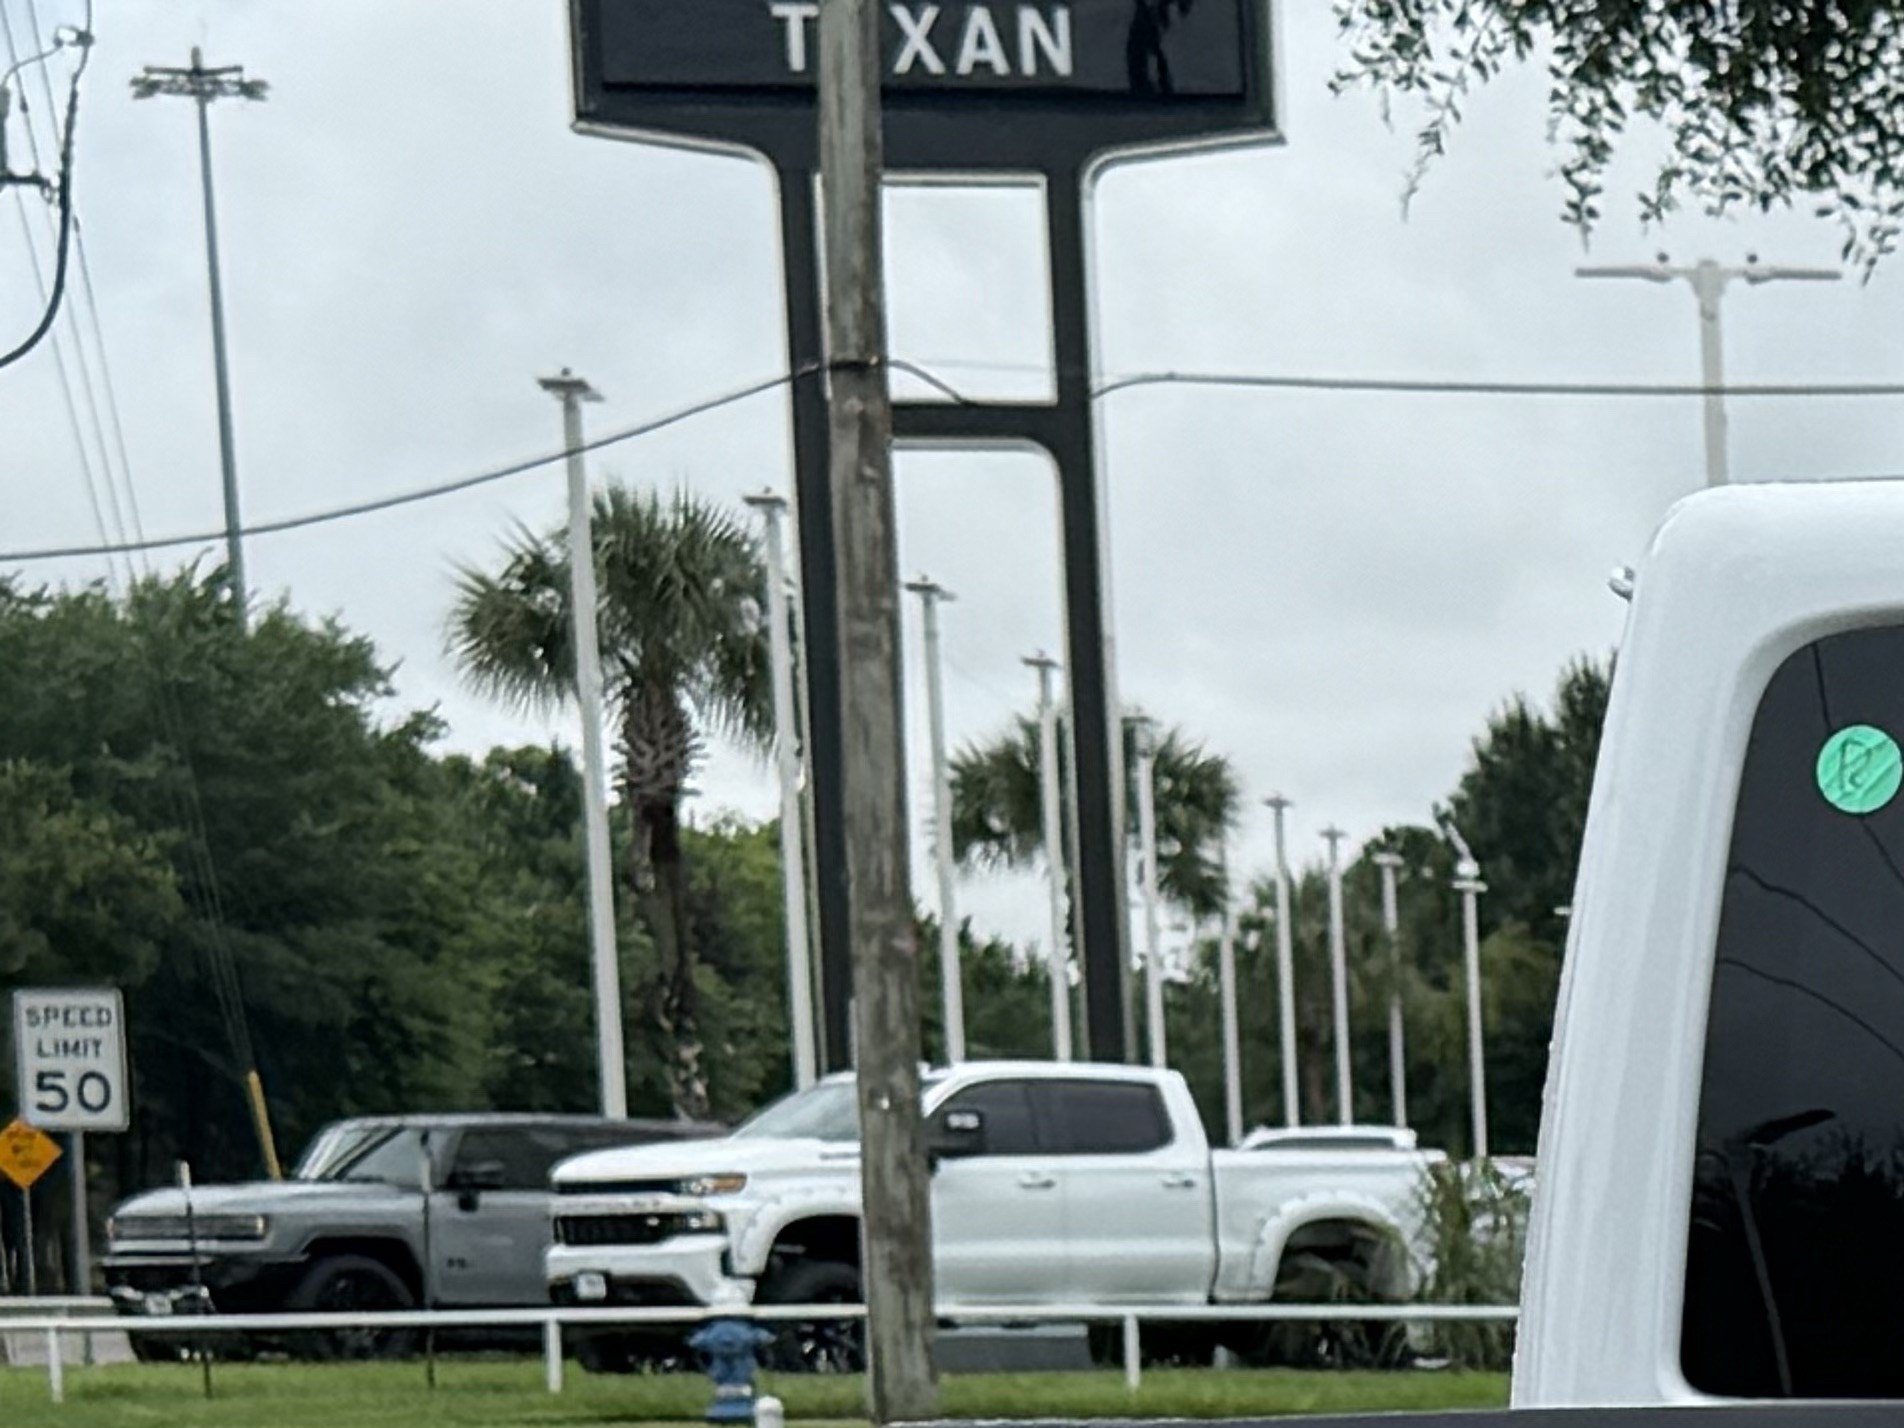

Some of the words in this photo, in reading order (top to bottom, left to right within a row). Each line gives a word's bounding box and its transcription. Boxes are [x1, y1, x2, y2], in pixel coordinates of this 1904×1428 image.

[769, 1, 1073, 77] TXAN
[26, 1006, 112, 1028] SPEED
[37, 1039, 103, 1059] LIMIT
[36, 1071, 112, 1113] 50
